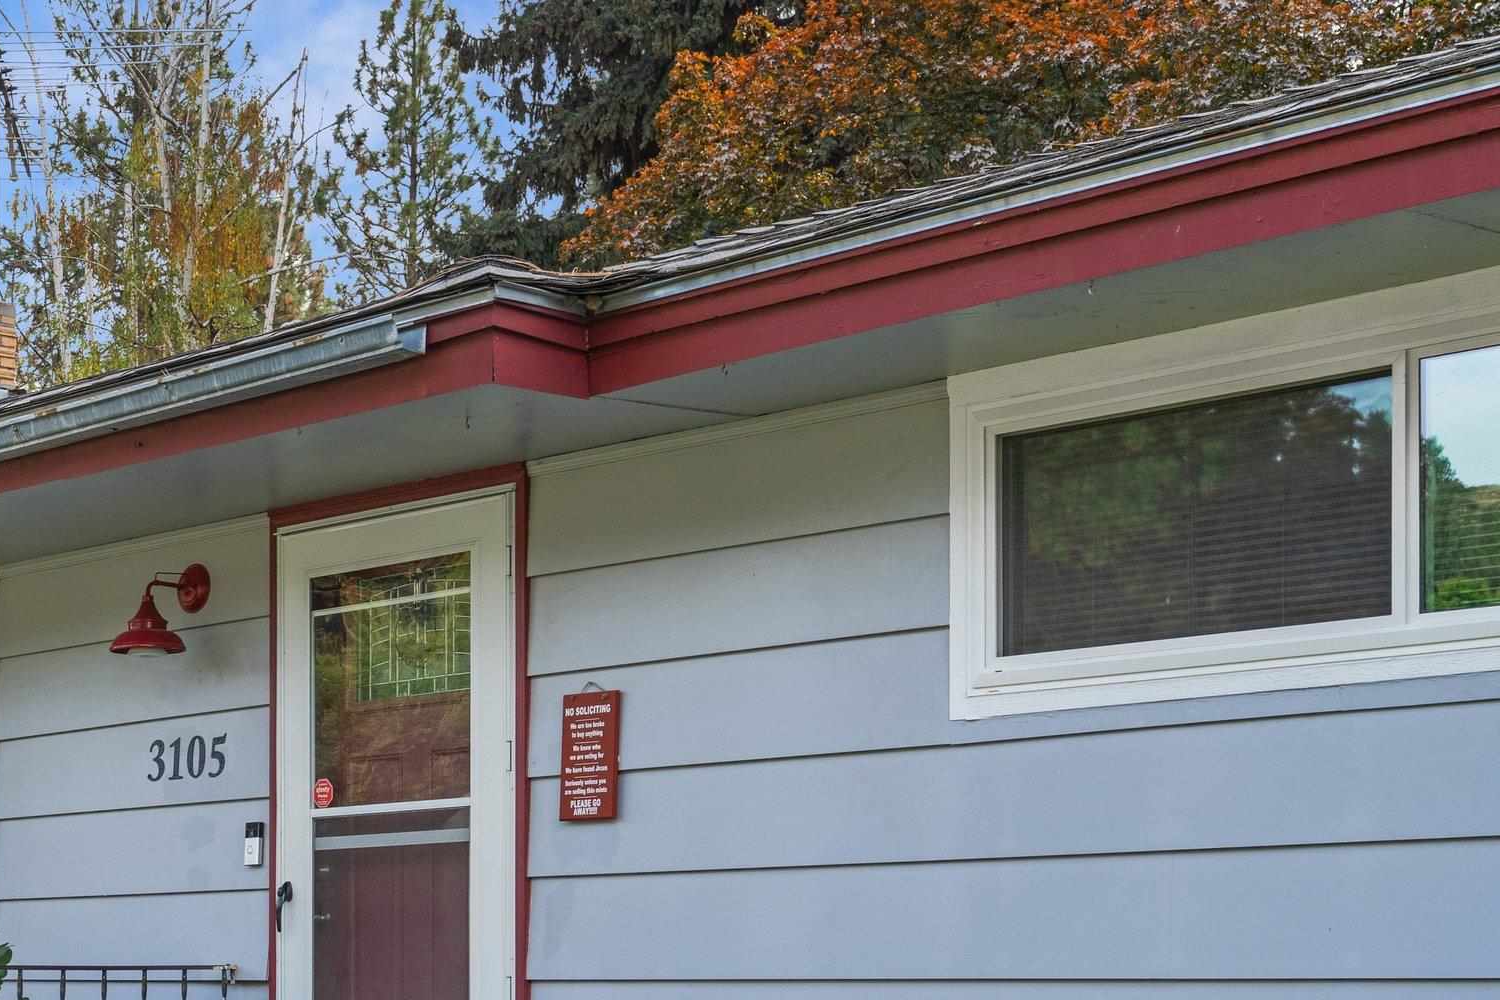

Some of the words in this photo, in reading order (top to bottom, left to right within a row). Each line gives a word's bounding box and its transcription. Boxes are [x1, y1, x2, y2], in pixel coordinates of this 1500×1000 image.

[565, 707, 574, 717] NO
[575, 704, 611, 716] SOLICITING
[147, 733, 228, 782] 3105
[570, 799, 592, 809] PLEASE
[592, 798, 601, 807] GO
